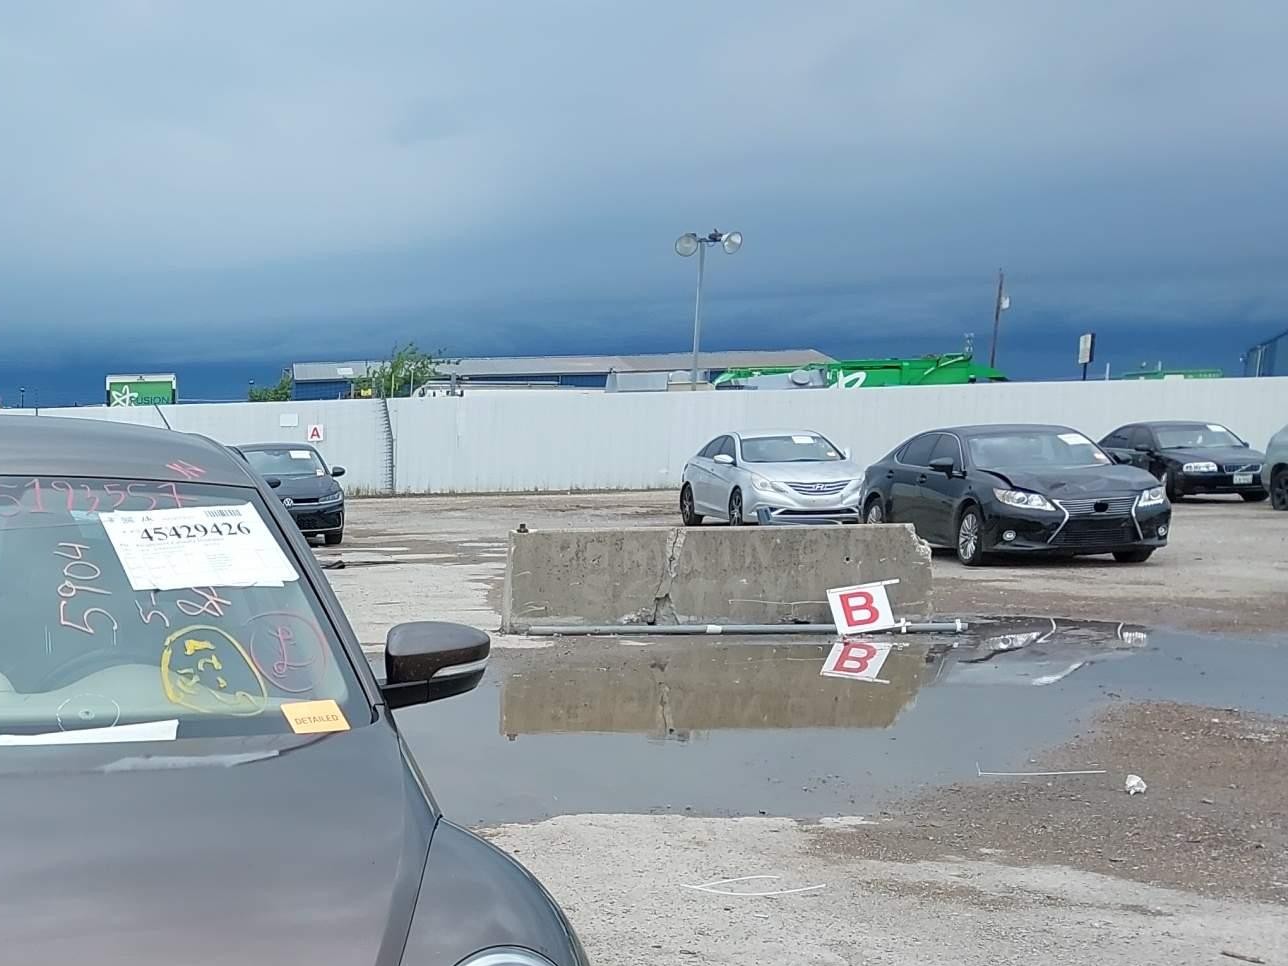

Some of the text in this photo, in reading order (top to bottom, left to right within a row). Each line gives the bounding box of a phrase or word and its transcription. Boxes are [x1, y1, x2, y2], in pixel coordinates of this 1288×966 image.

[310, 427, 322, 440] A
[140, 520, 251, 542] 45429426
[839, 591, 880, 627] B
[294, 714, 340, 725] DETAILED
